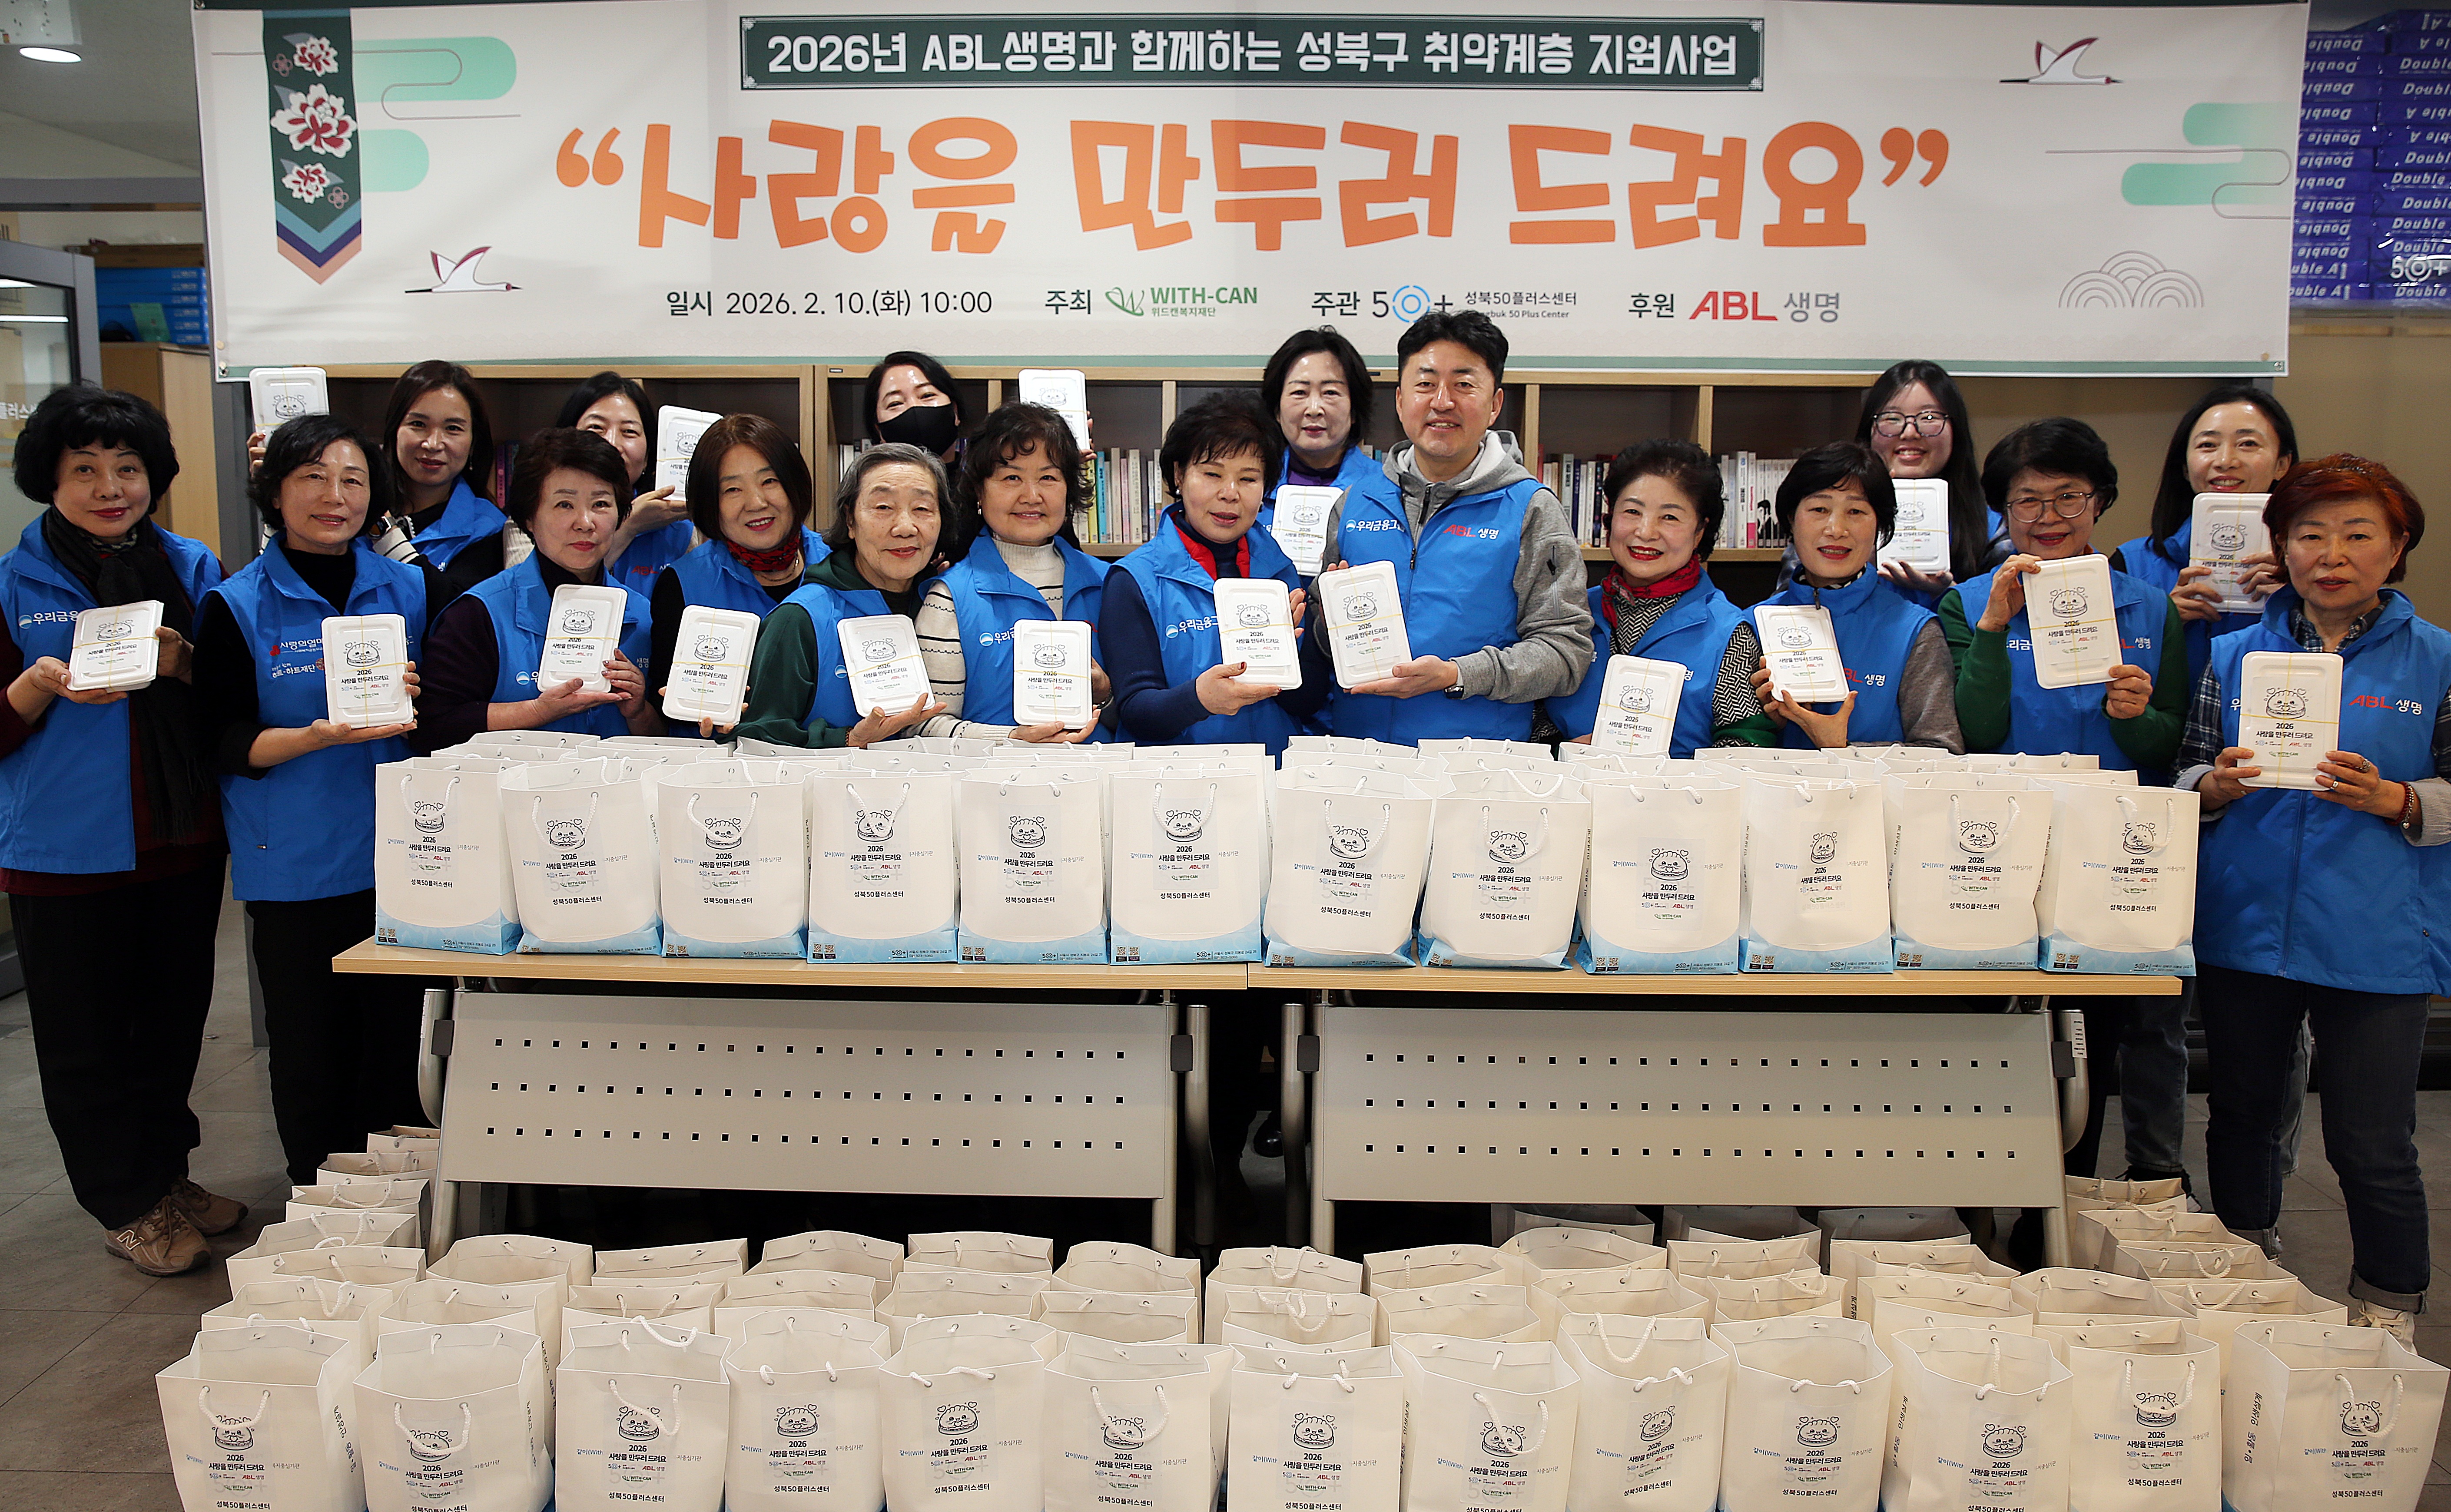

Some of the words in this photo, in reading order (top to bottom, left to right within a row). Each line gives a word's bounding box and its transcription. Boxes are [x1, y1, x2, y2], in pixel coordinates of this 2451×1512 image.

[768, 32, 907, 73] 2026년
[922, 31, 1118, 73] ABL생명과
[1131, 30, 1282, 72] 함께하는
[1296, 32, 1410, 73] 성북구
[1423, 31, 1574, 75] 취약계층
[1589, 31, 1737, 76] 지원사업
[2402, 83, 2451, 95] Doubl
[1070, 119, 1459, 252] 만두러
[2391, 172, 2446, 185] Double
[2392, 218, 2446, 229] Double
[1045, 289, 1091, 315] 주최
[1151, 287, 1258, 304] WITH-CAN
[1465, 291, 1577, 306] 성북50플러스센터
[667, 291, 713, 317] 일시
[726, 292, 797, 315] 2026.
[804, 292, 826, 315] 2.
[921, 291, 993, 314] 10:00
[1311, 291, 1361, 317] 주관
[1628, 292, 1675, 319] 후원
[1689, 291, 1778, 320] ABL
[1784, 292, 1841, 323] 생명
[1151, 307, 1217, 318] 위드캔복지재단
[1509, 310, 1520, 318] 50
[1522, 310, 1539, 318] Plus
[1541, 310, 1569, 318] Center
[1443, 524, 1476, 537] ABL
[1478, 528, 1499, 540] 생명
[631, 566, 659, 576] ABL
[2135, 637, 2151, 649] 생명
[1844, 668, 1863, 683] BL
[1864, 674, 1885, 686] 생명
[2349, 695, 2394, 710] ABL
[2395, 699, 2423, 715] 생명
[950, 1438, 968, 1447] 2026
[1647, 1440, 1662, 1452] 2026
